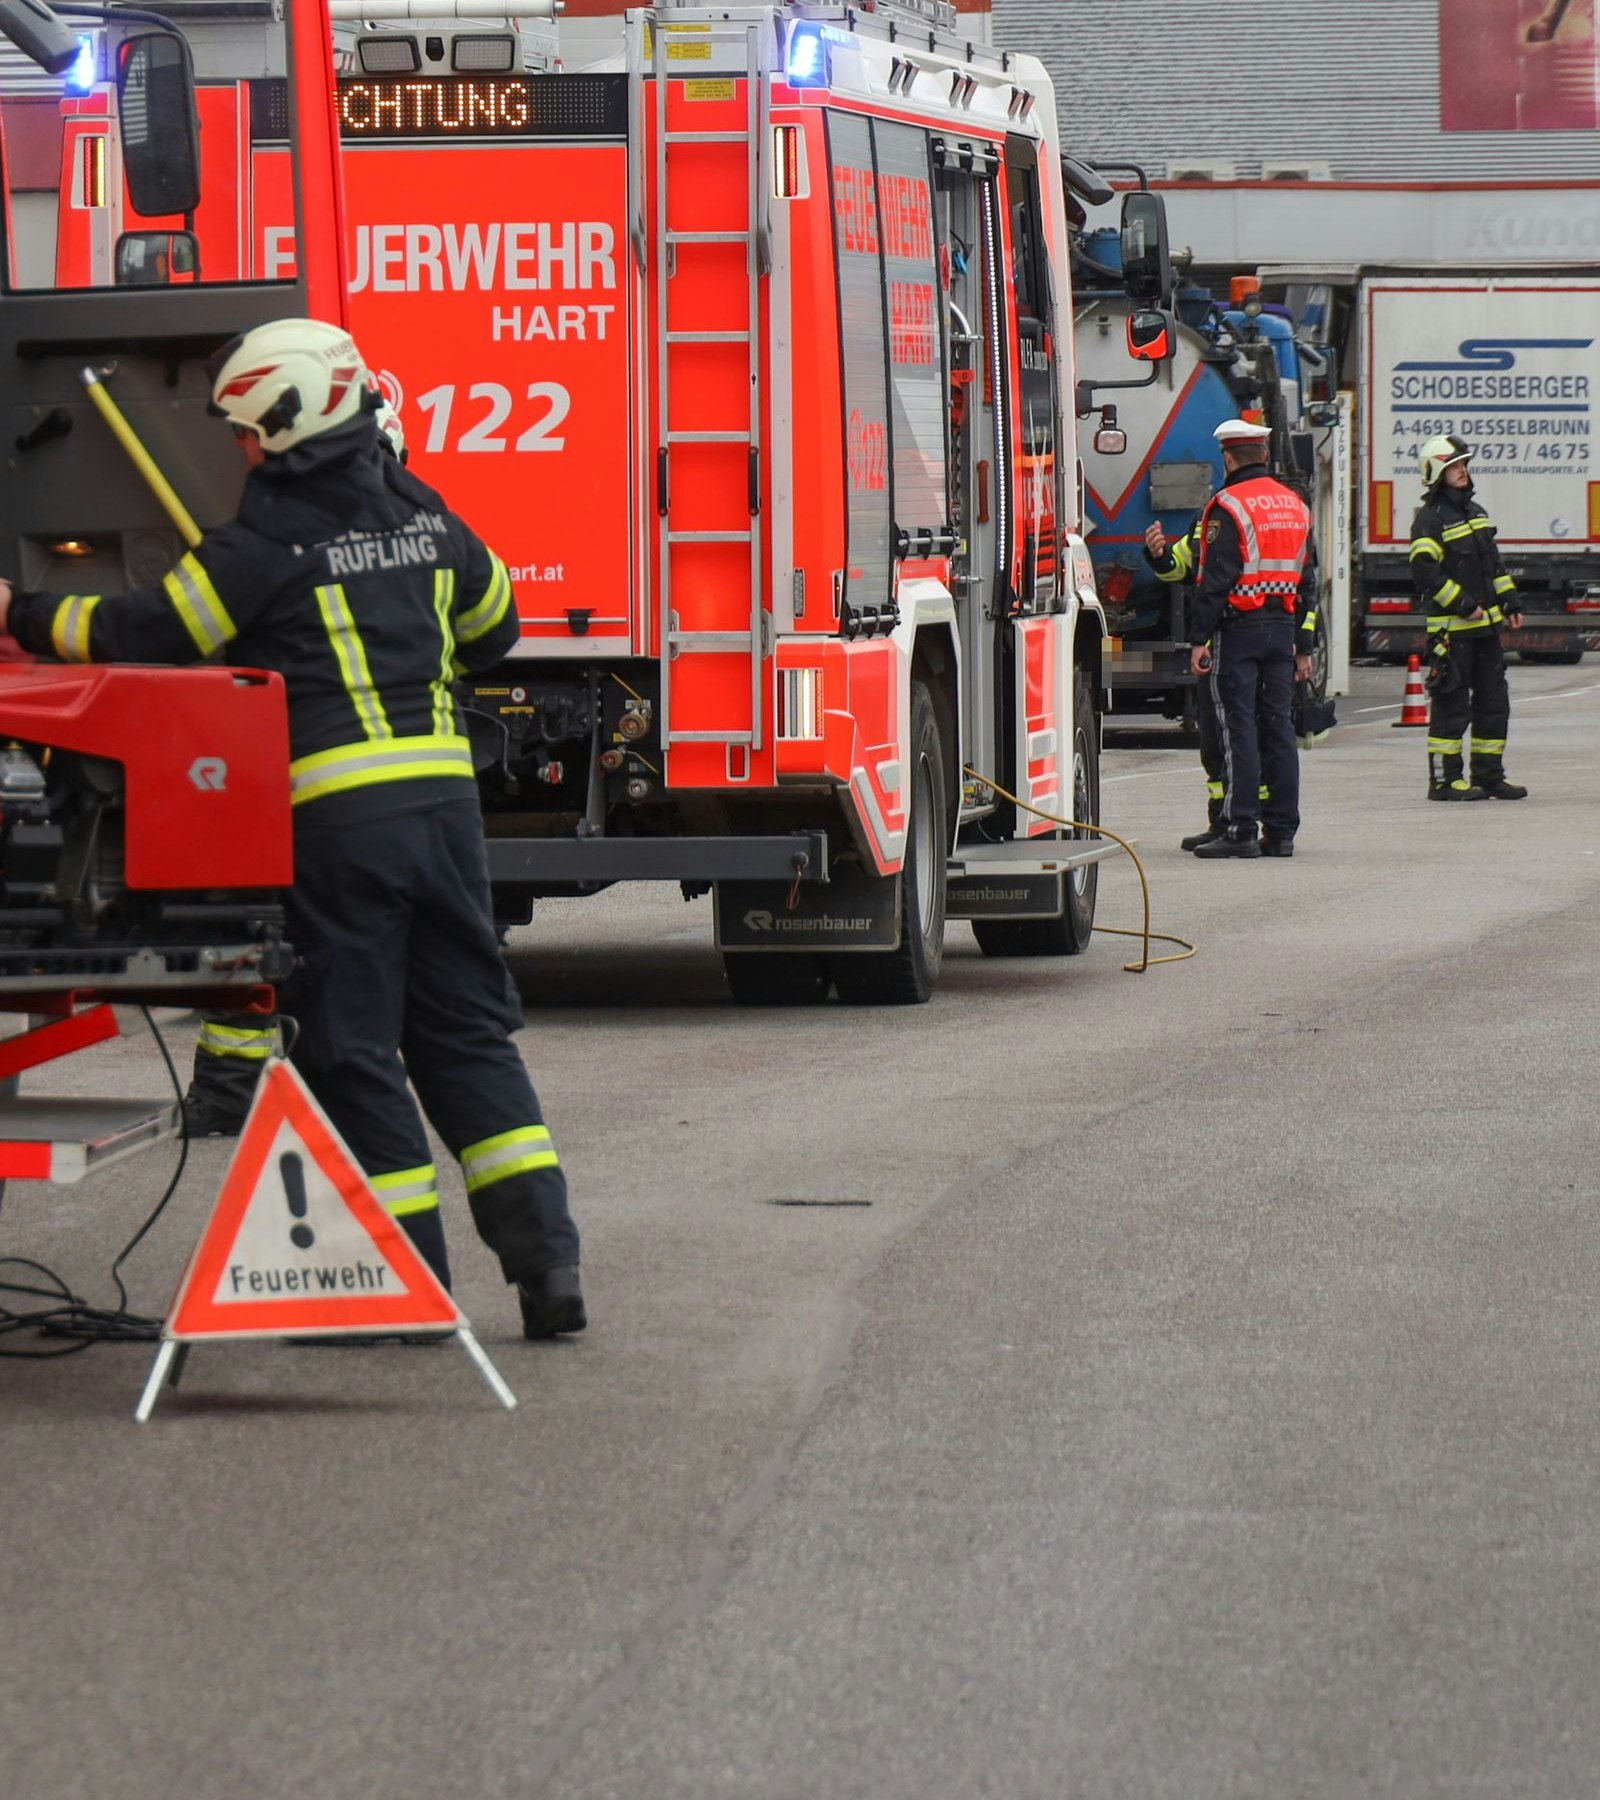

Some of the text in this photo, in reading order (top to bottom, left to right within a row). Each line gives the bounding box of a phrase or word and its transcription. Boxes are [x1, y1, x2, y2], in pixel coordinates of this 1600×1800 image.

[333, 82, 528, 129] CHTUNG
[263, 221, 617, 294] FUERWEHR
[491, 305, 615, 341] HART
[891, 280, 932, 364] HART
[1391, 376, 1589, 399] SCHOBESBERGER
[415, 381, 571, 453] 122
[1392, 419, 1590, 436] A-4693 DESSELBRUNN
[326, 535, 438, 576] RUFLING
[948, 886, 1031, 901] osenbauer
[775, 914, 873, 932] rosenbauer
[230, 1260, 386, 1293] Feuerwehr
